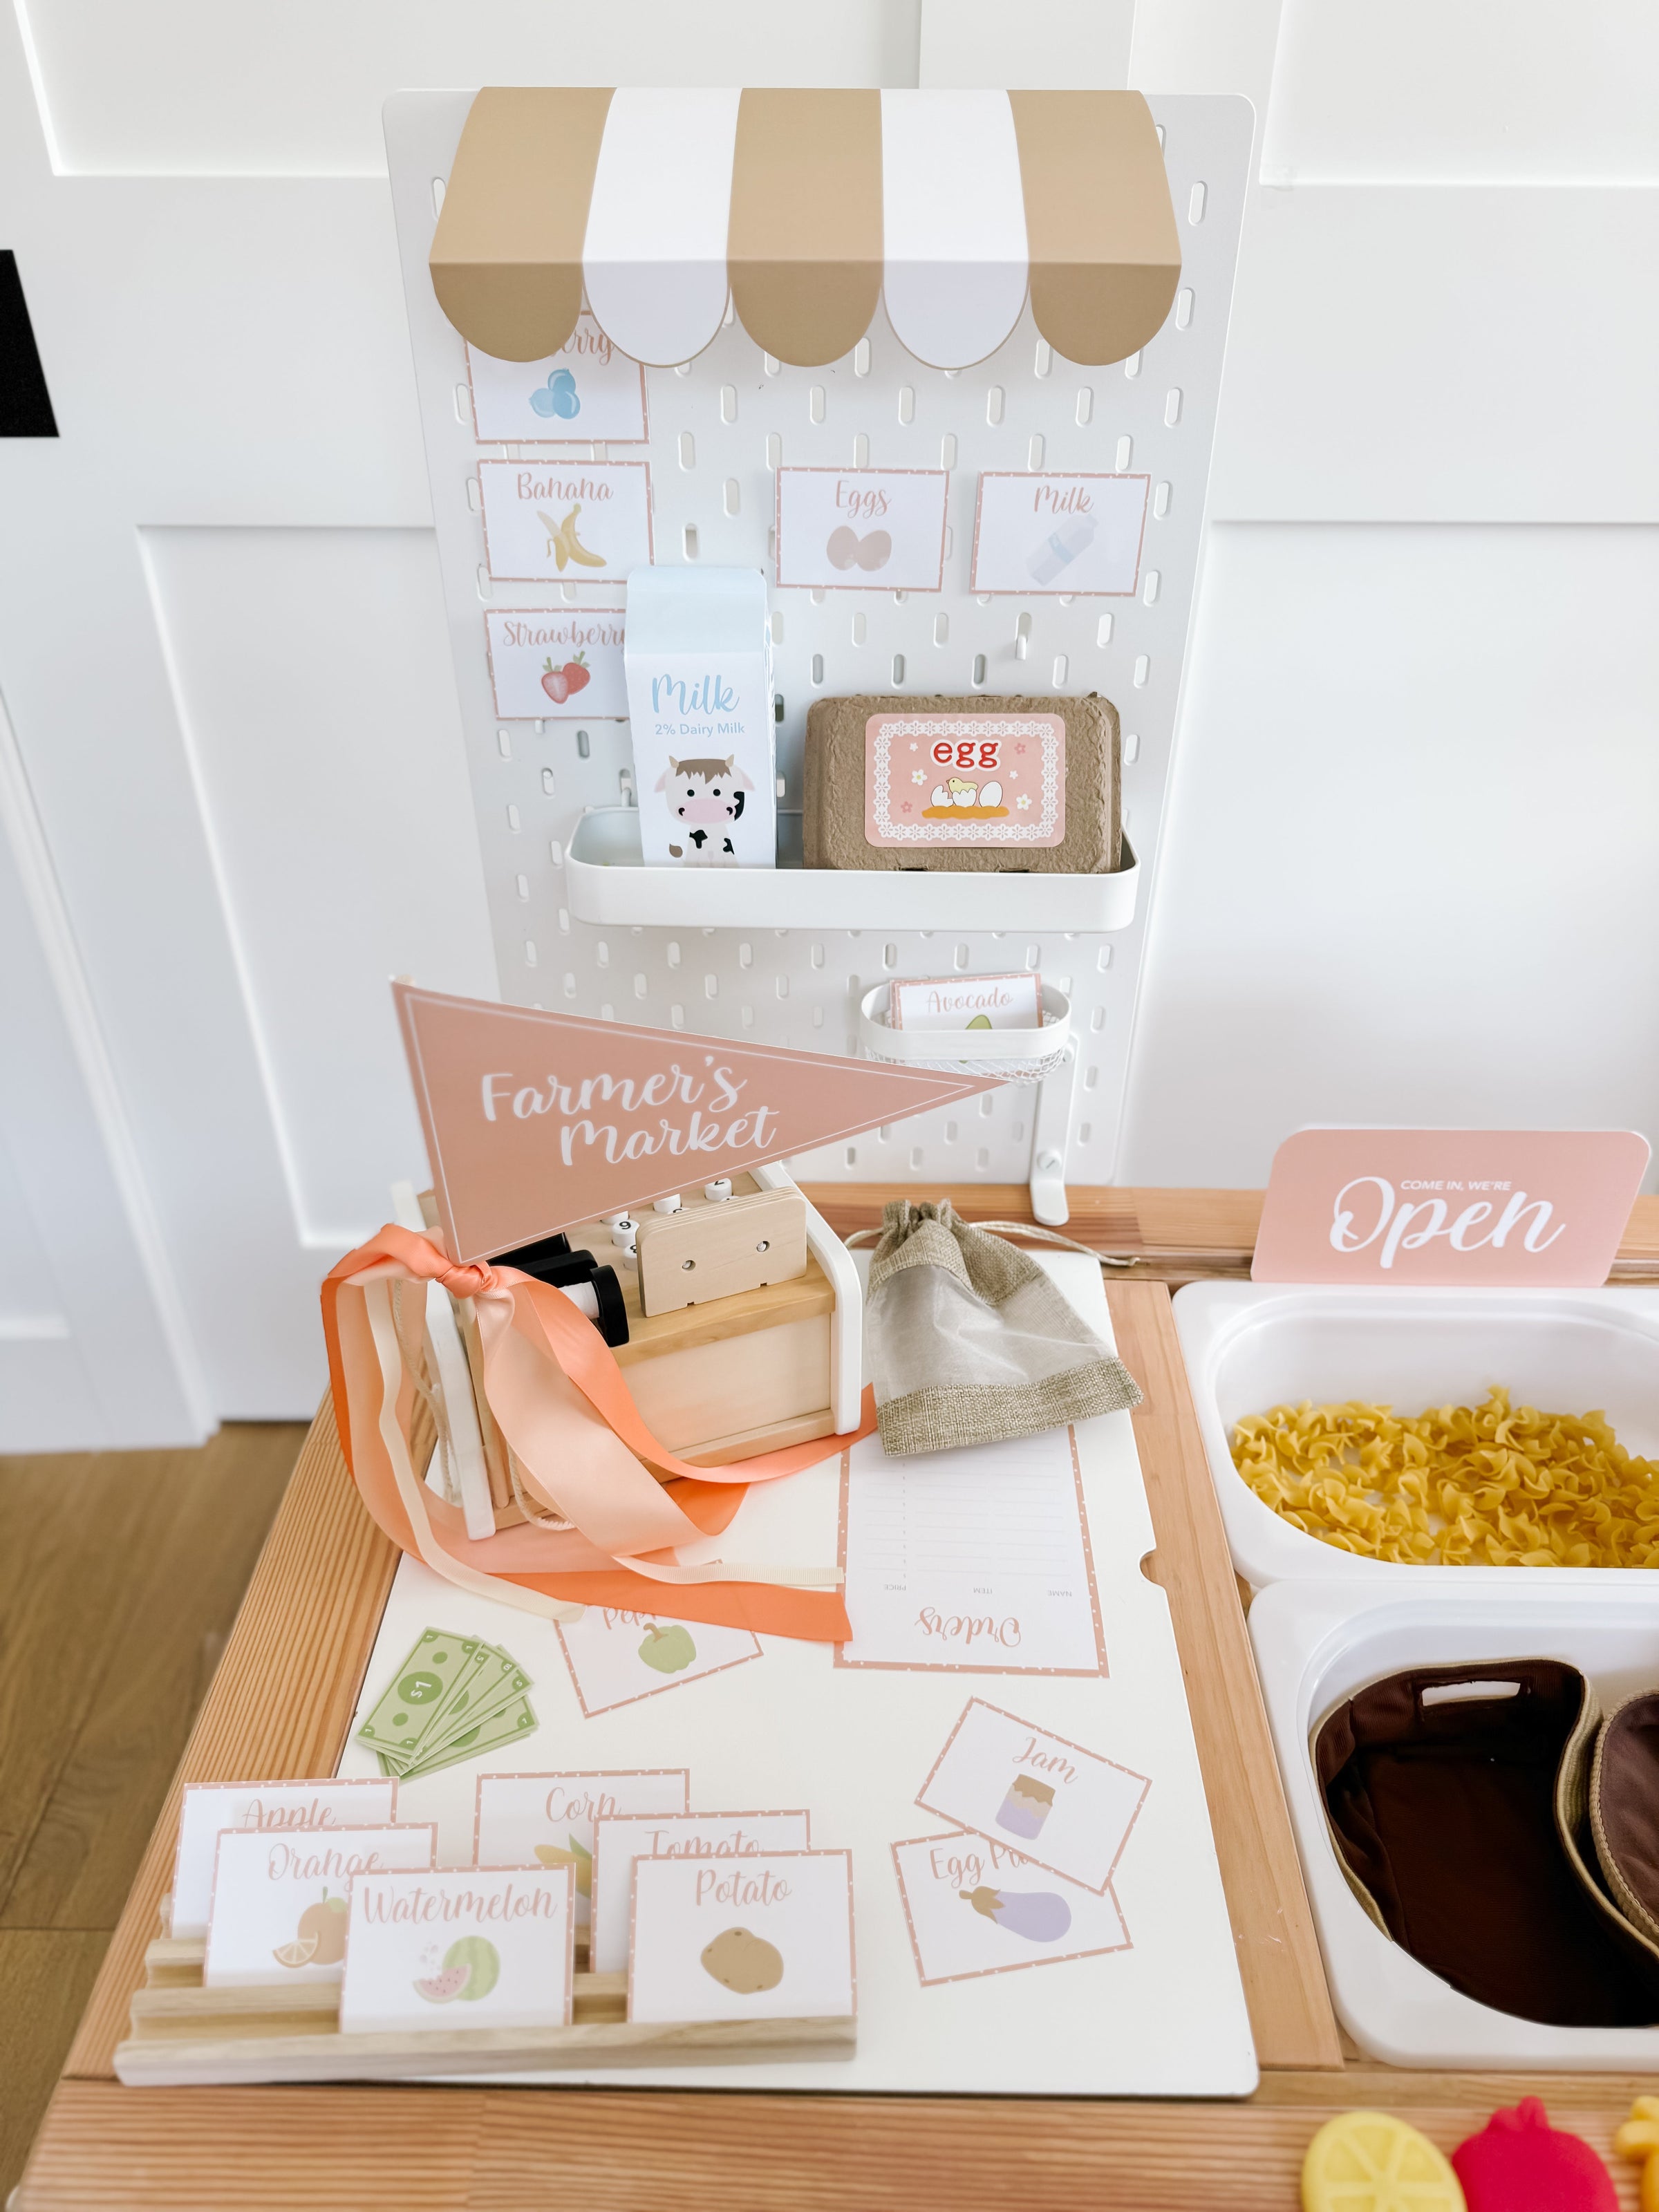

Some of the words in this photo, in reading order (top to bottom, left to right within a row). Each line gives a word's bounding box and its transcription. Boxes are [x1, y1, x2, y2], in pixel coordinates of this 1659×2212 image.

[517, 471, 614, 501] Banana
[835, 480, 892, 518] Eggs
[1034, 485, 1094, 514] Milk
[652, 673, 740, 715] Milk
[655, 724, 676, 735] 2%
[679, 723, 713, 738] Dairy
[718, 722, 745, 733] Milk
[932, 740, 1000, 770] egg
[927, 987, 1013, 1013] Avocado
[482, 1056, 747, 1122] Farmer's
[561, 1105, 780, 1166] Market
[1400, 1180, 1445, 1190] COME
[1446, 1181, 1464, 1192] IN,
[1468, 1181, 1512, 1191] WE'RE
[1330, 1176, 1566, 1269] Open
[915, 1606, 1021, 1647] Orders
[410, 1680, 432, 1698] $1
[1012, 1737, 1078, 1783] Jam
[242, 1798, 336, 1827] Apple
[546, 1787, 621, 1822] Corn
[268, 1843, 384, 1892] Orange
[930, 1848, 985, 1888] Egg
[363, 1883, 557, 1924] Watermelon
[696, 1869, 791, 1906] Potato
